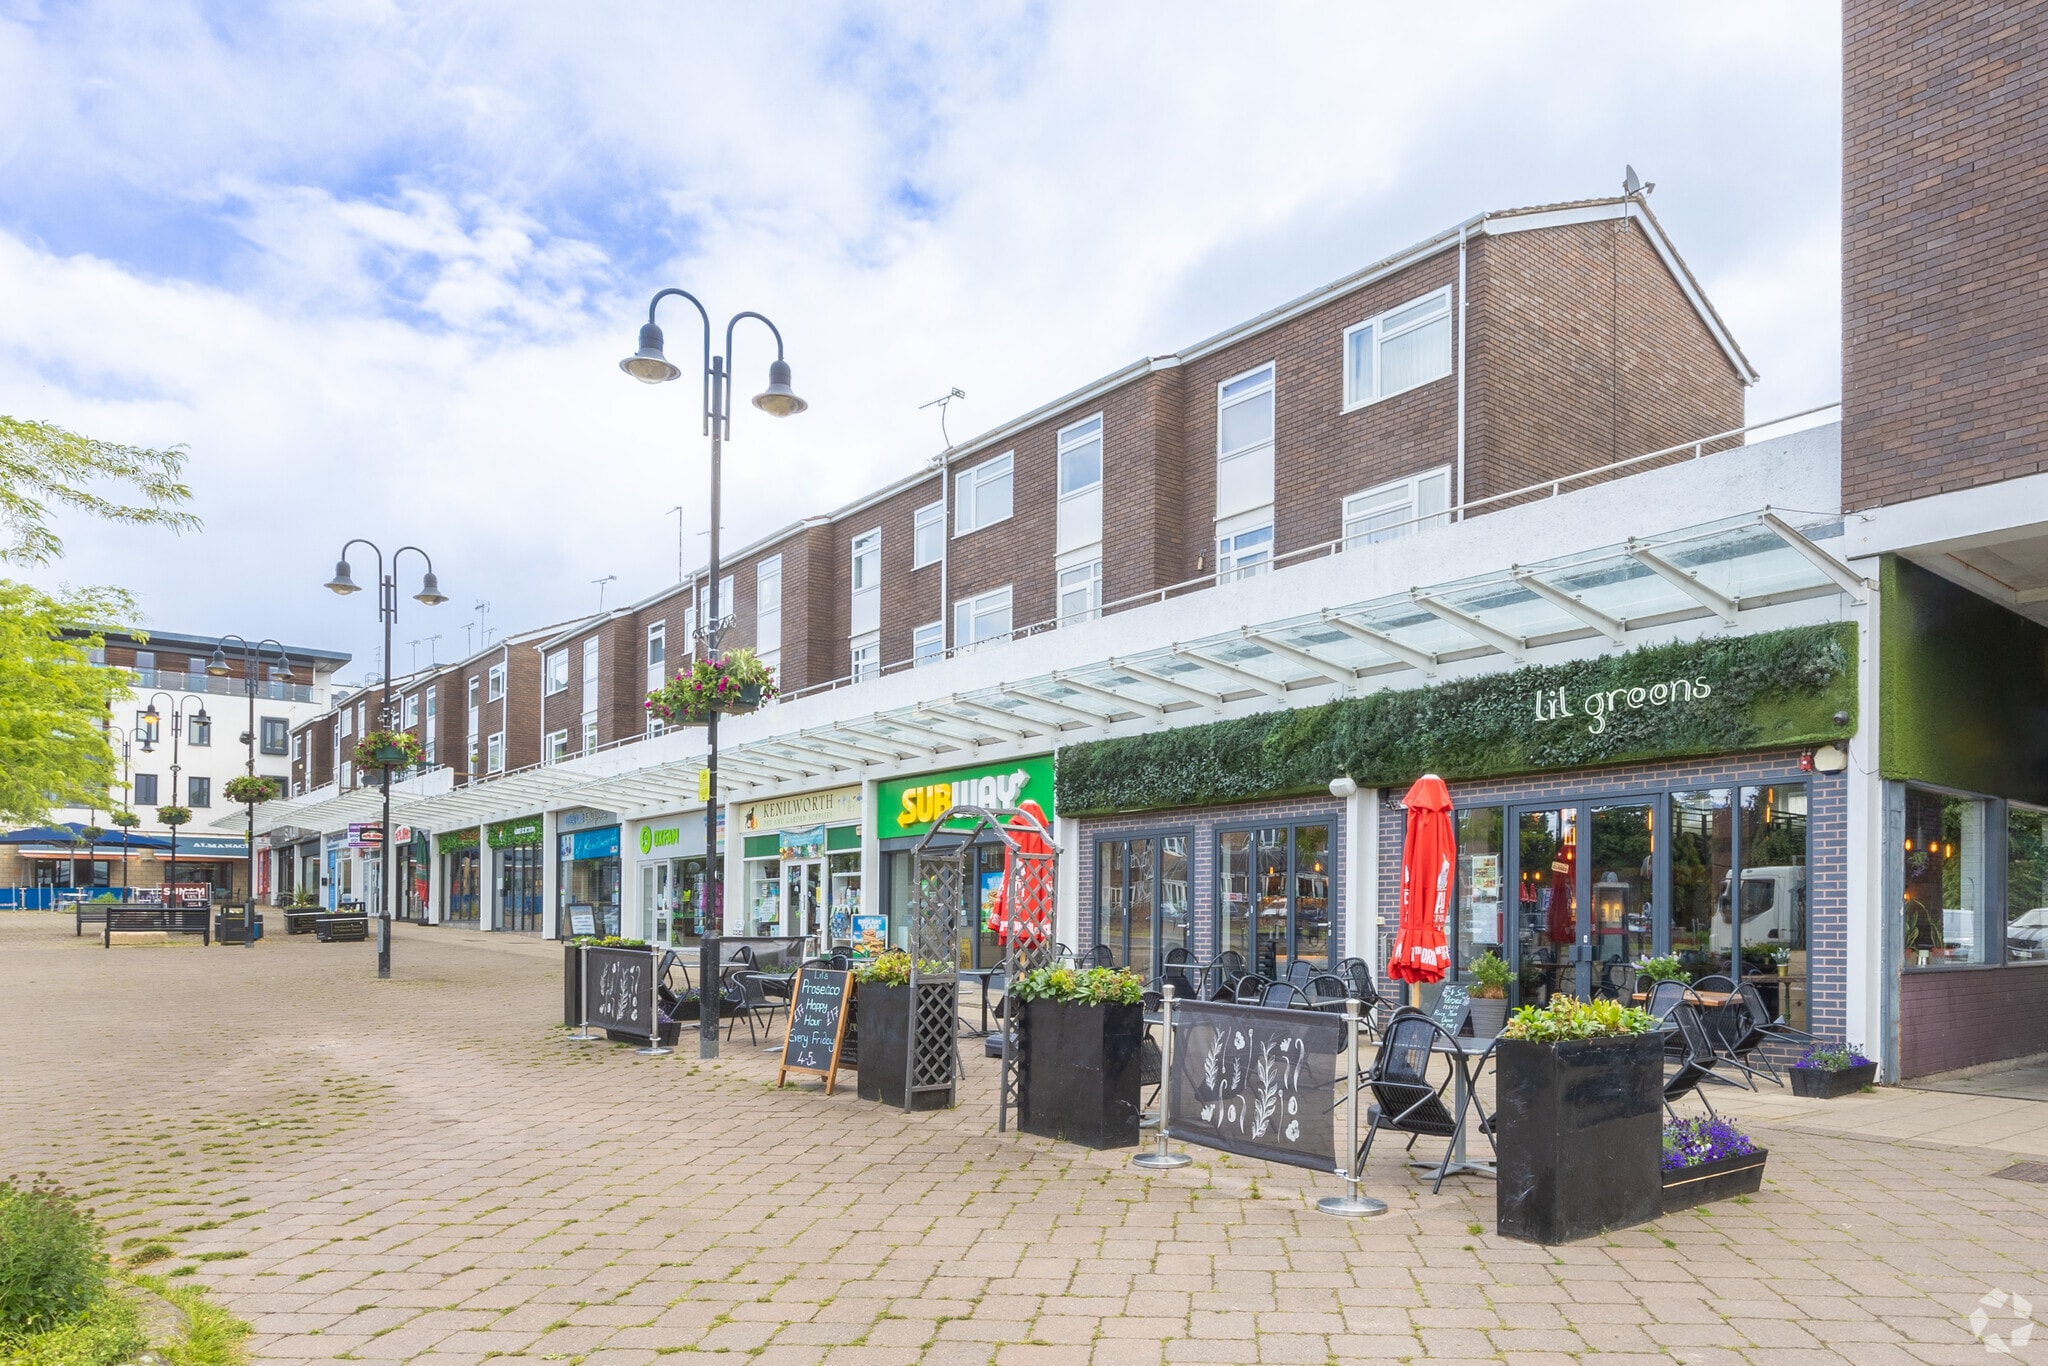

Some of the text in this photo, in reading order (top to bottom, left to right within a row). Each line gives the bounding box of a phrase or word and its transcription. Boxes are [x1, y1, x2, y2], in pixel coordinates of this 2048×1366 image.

[1535, 676, 1711, 734] lil greens
[763, 794, 833, 818] KENILWORTH
[897, 769, 1030, 828] SUBWAY
[654, 828, 680, 848] OXFAM
[802, 978, 841, 996] Prosecco
[806, 998, 828, 1014] Happy
[803, 1014, 822, 1027] Hour
[788, 1028, 836, 1053] Every Friday
